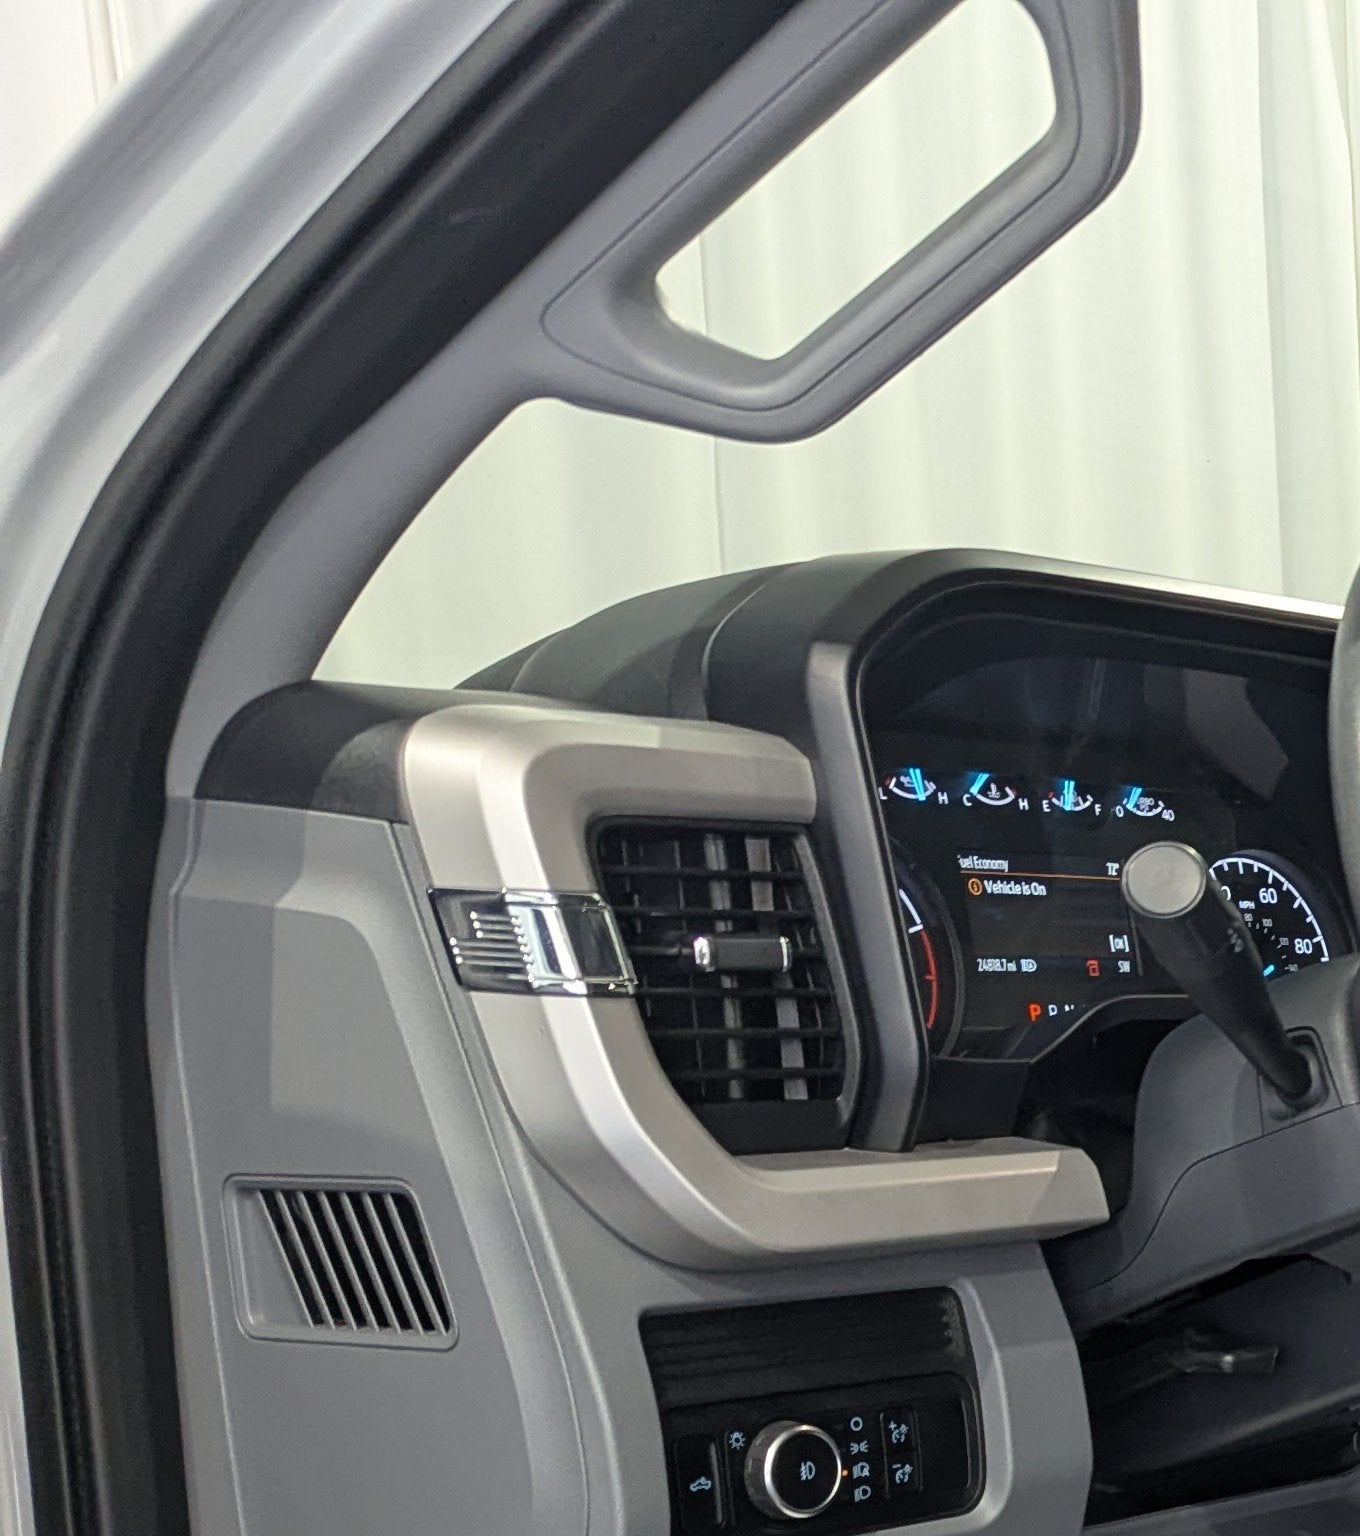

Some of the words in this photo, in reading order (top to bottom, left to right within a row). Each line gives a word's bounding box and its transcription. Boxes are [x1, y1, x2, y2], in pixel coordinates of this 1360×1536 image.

[878, 787, 888, 800] L
[937, 791, 949, 805] H
[962, 794, 973, 807] C
[1018, 798, 1029, 810] H
[1042, 799, 1051, 812] E
[1094, 803, 1102, 816] F
[1161, 809, 1175, 822] 40
[973, 855, 1009, 873] Economy
[983, 879, 1022, 895] Vehicle
[1022, 881, 1031, 895] is
[1031, 882, 1047, 896] On
[1258, 887, 1278, 904] 60
[1294, 938, 1313, 955] 80
[1029, 1003, 1042, 1022] P
